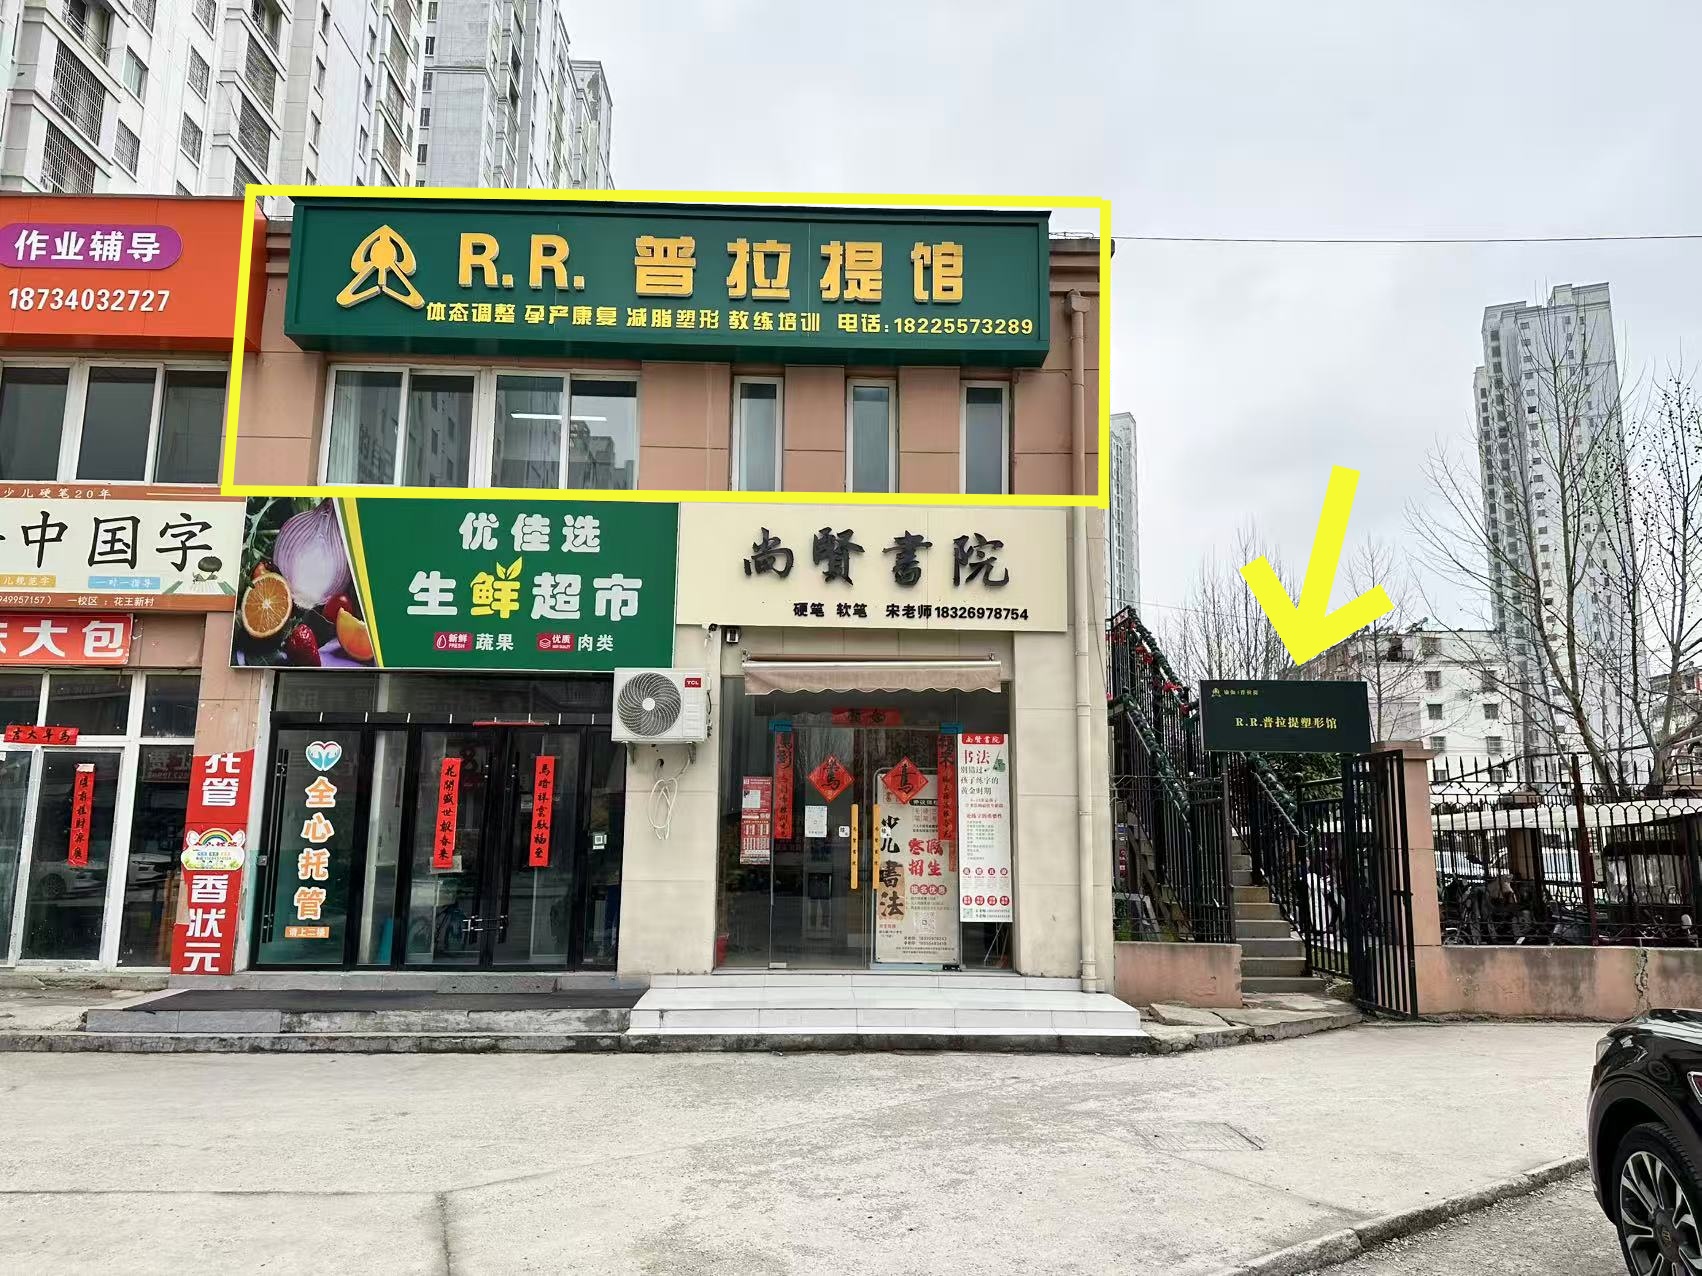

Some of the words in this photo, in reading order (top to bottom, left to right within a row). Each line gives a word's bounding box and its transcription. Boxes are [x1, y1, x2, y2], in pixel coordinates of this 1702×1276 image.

[14, 229, 160, 263] 作业辅导
[458, 233, 584, 290] R.R.
[634, 235, 964, 304] 普拉提馆
[8, 287, 171, 312] 18734032727
[426, 303, 515, 324] 体态调整
[524, 305, 617, 327] 孕产康复
[626, 307, 720, 329] 减脂塑形
[728, 310, 820, 332] 教练培训
[0, 510, 213, 572] 中国字
[459, 512, 600, 552] 优佳选
[407, 570, 642, 621] 生鲜超市
[793, 602, 825, 618] 硬笔
[836, 602, 868, 619] 软笔
[0, 619, 125, 659] 大包
[448, 633, 468, 643] 新鲜
[475, 633, 515, 651] 蔬果
[552, 634, 571, 644] 优质
[577, 634, 614, 651] 肉类
[963, 749, 990, 766] 书法
[202, 752, 241, 806] 托管
[294, 776, 337, 920] 全心托管
[908, 859, 943, 877] 招生
